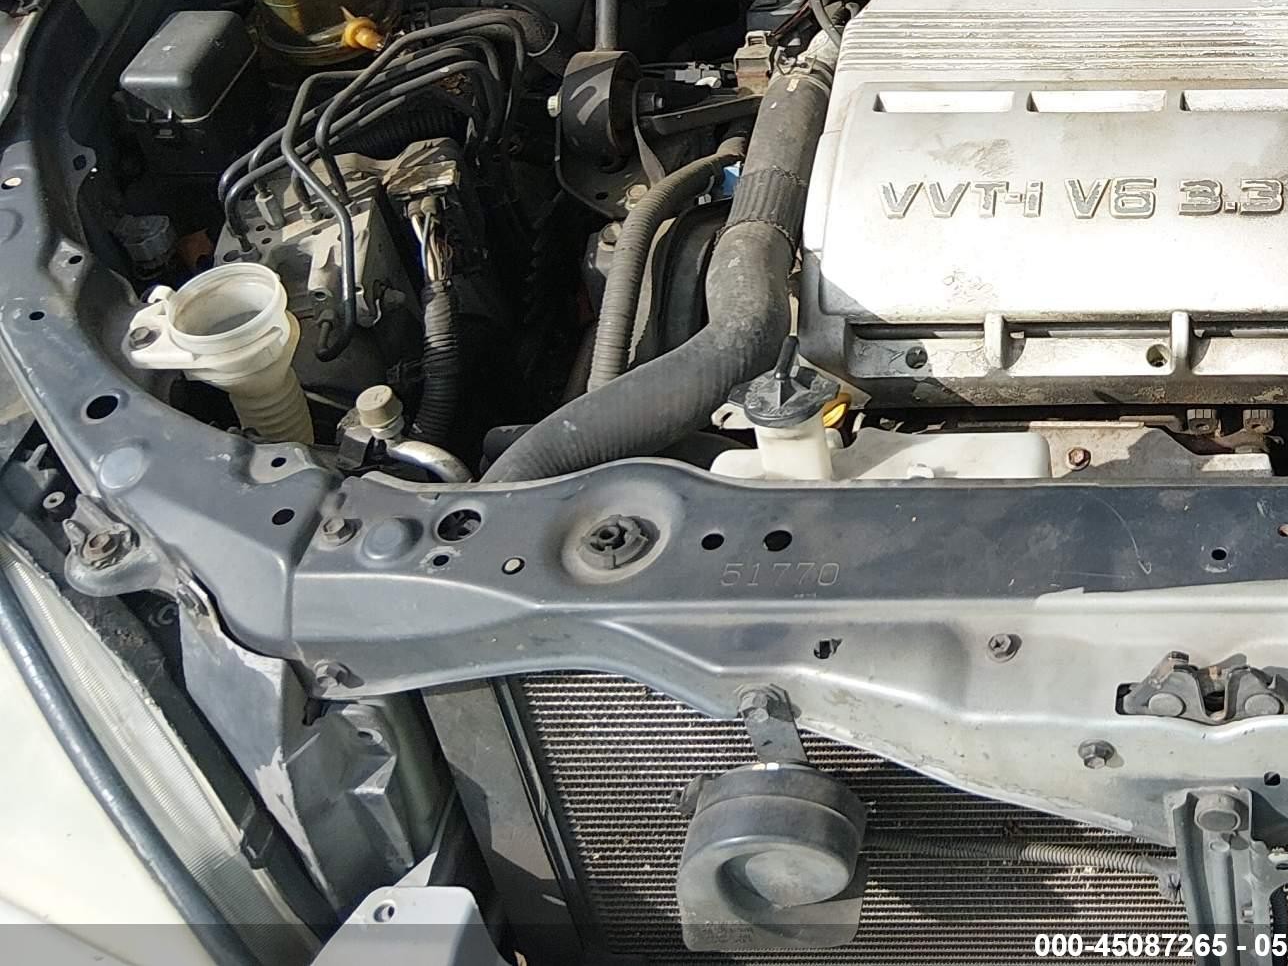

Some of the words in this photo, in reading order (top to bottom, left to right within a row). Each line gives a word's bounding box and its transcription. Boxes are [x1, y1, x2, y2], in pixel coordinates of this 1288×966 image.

[1063, 177, 1158, 220] V6
[1177, 178, 1286, 217] 3.3
[720, 562, 840, 586] 51770
